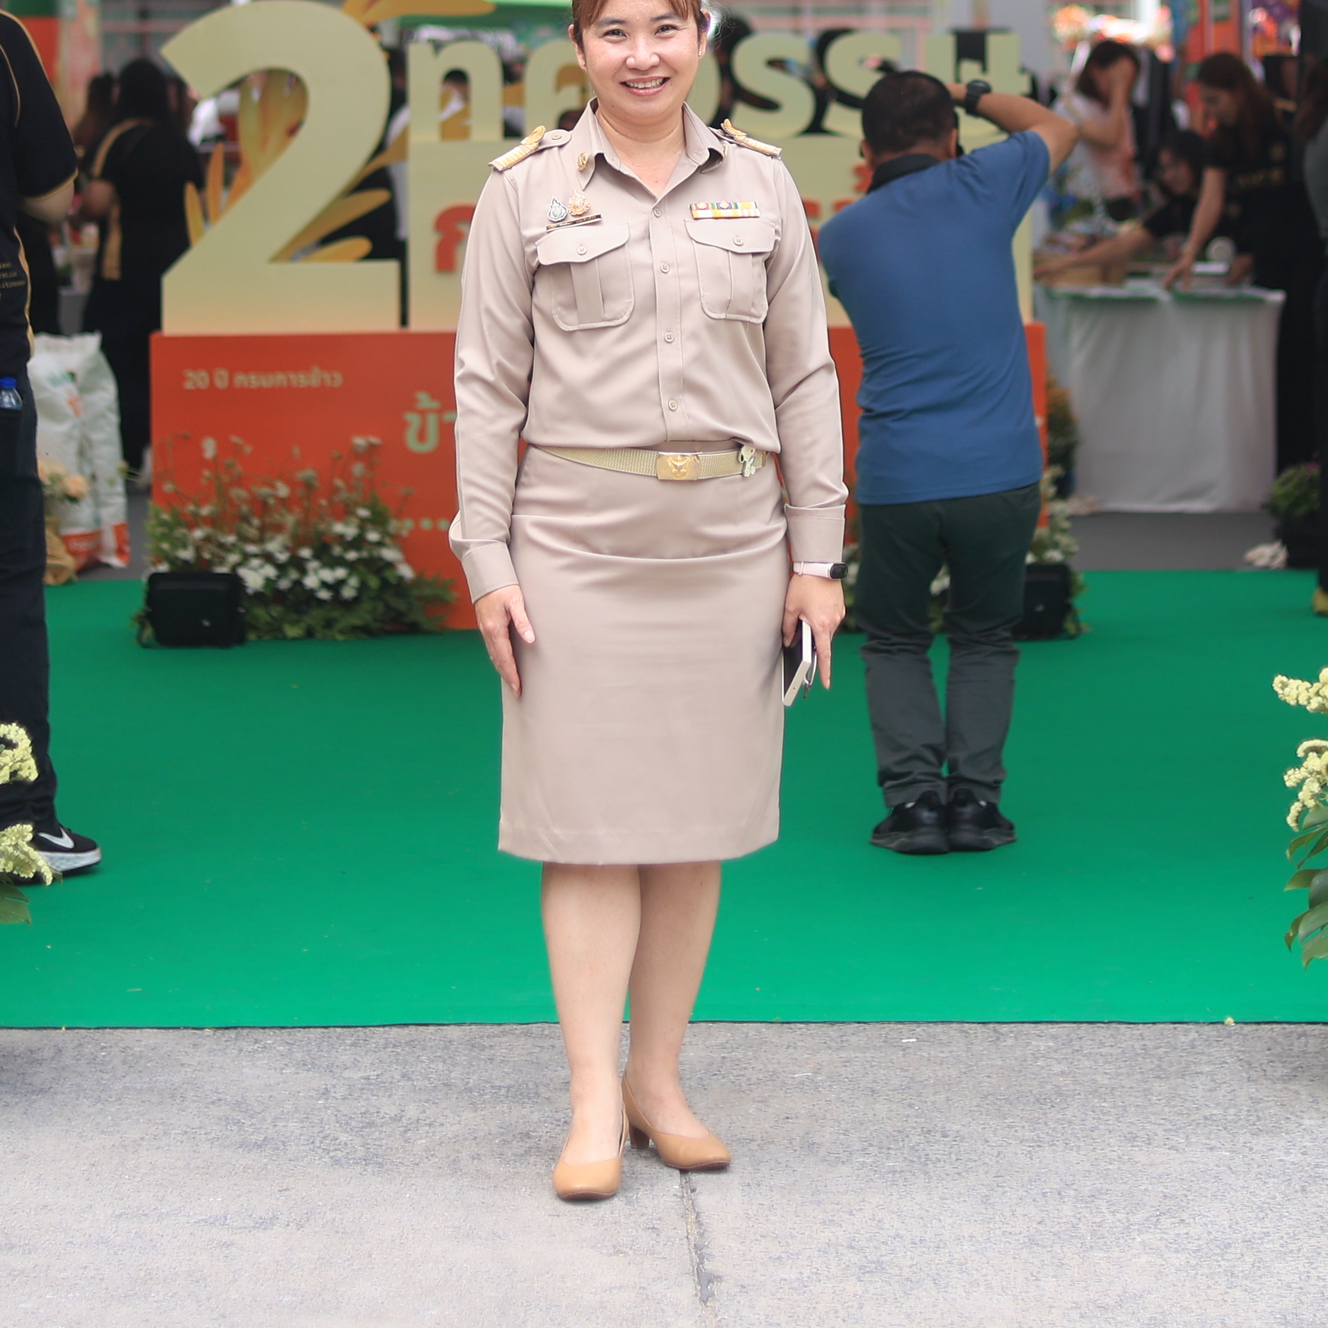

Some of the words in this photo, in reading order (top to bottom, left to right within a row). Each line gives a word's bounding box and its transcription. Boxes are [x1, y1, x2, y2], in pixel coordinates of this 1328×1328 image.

[183, 369, 210, 390] 20
[213, 366, 230, 390] ปี
[234, 365, 344, 389] กรมการข้าว
